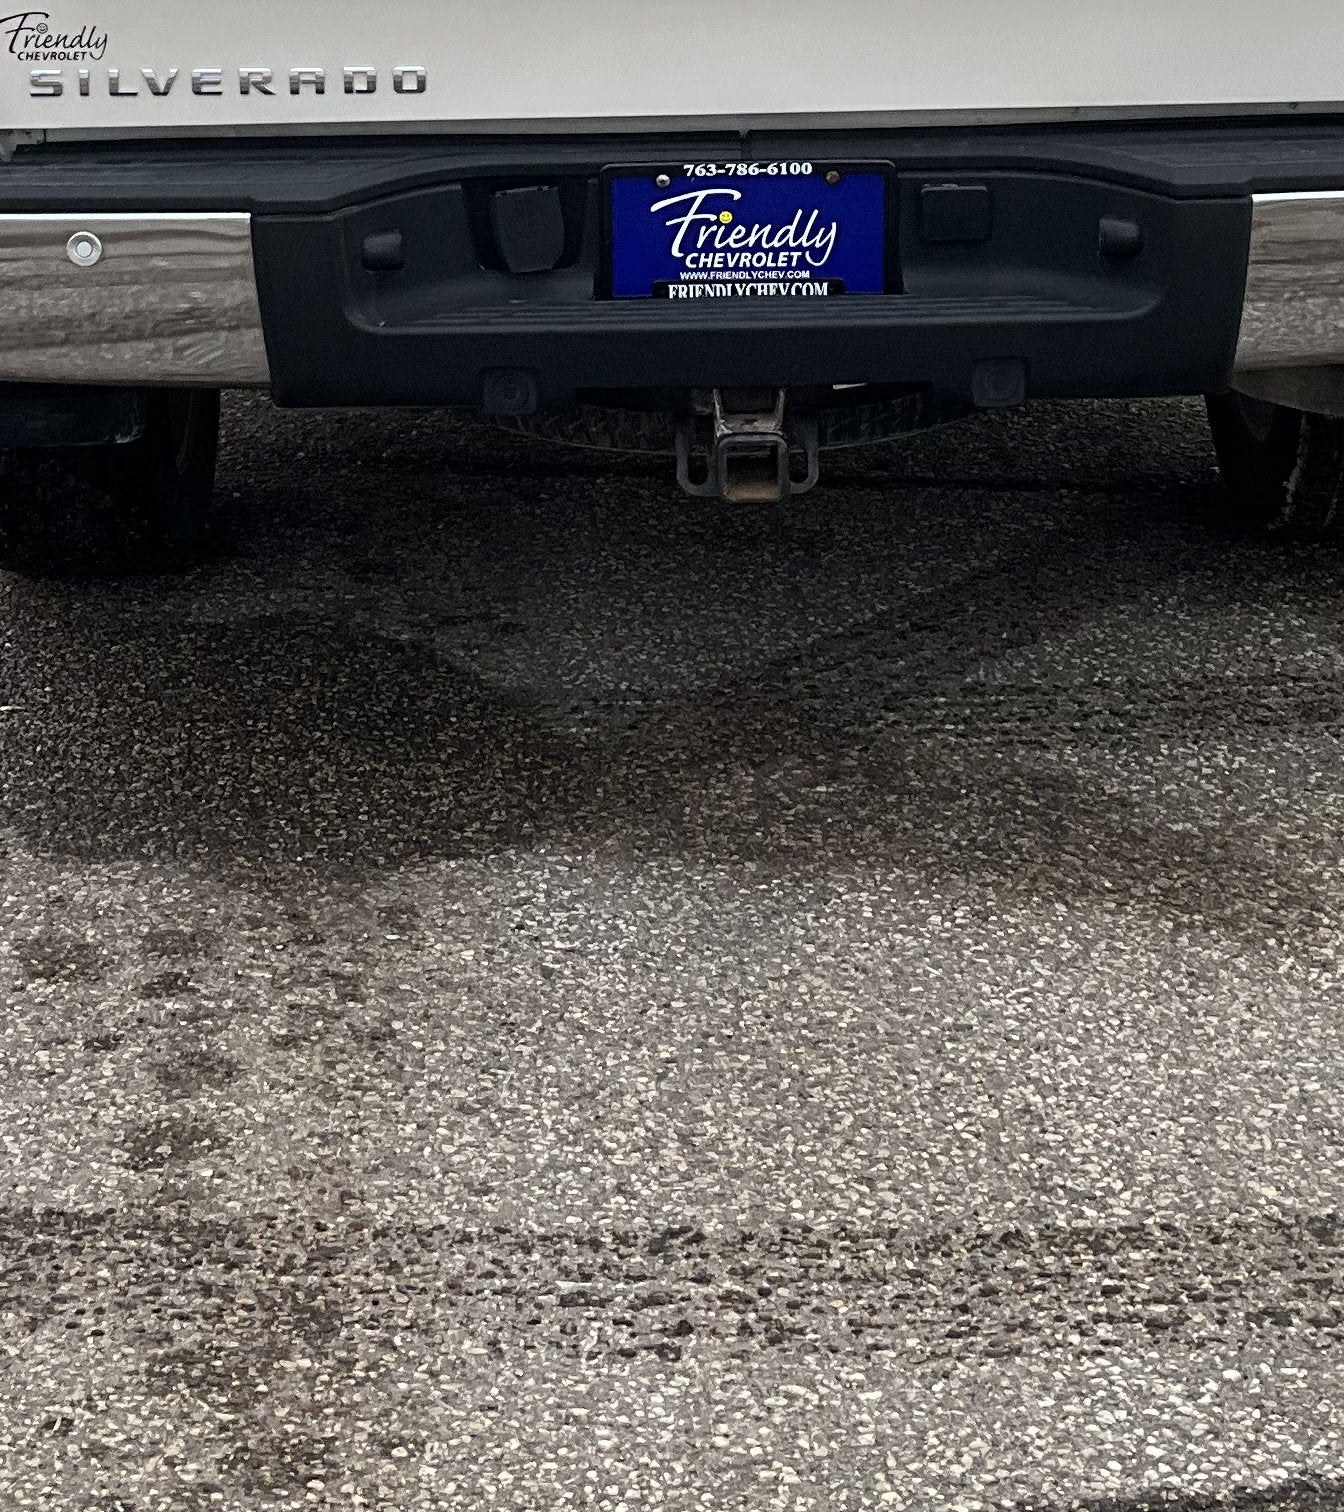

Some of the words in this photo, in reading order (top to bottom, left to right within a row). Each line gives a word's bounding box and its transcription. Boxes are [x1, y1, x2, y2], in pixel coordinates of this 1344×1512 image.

[17, 51, 88, 61] CHEVROLET
[29, 65, 427, 97] SILVERADO
[683, 162, 813, 176] 763-786-6100
[650, 188, 837, 267] Friendly
[685, 251, 802, 268] CHEVROLET
[679, 270, 811, 280] WWW.FRIENDLYCHEV.COM
[668, 282, 829, 299] FRIENDLYCHEVCOM
